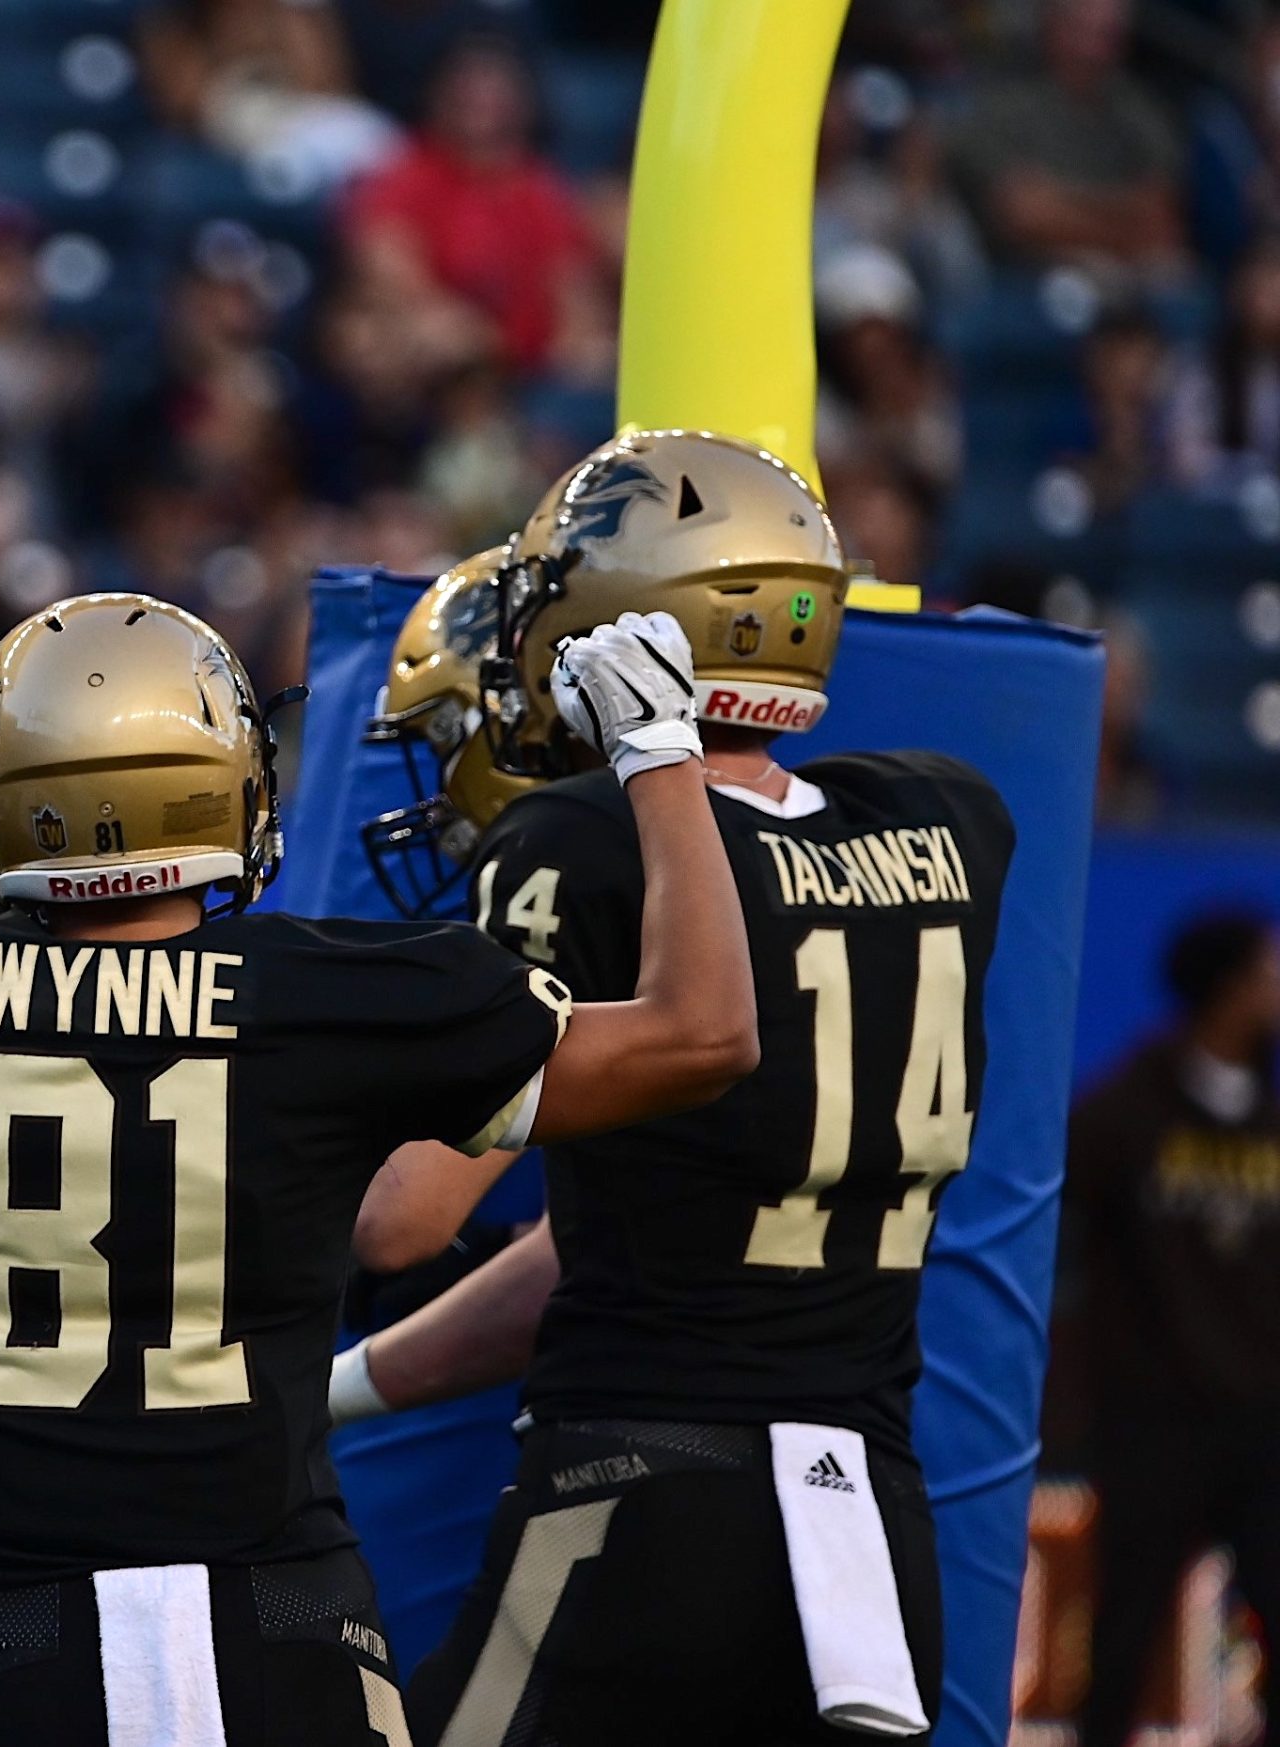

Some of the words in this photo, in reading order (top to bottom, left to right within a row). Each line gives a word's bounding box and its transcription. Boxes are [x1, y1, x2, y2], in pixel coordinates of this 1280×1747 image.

[95, 820, 125, 852] 81
[48, 864, 181, 899] Riddell
[757, 826, 971, 907] TACHINSKI
[744, 925, 974, 1269] 14
[551, 1453, 650, 1496] MANITOBA
[804, 1473, 856, 1493] adidas
